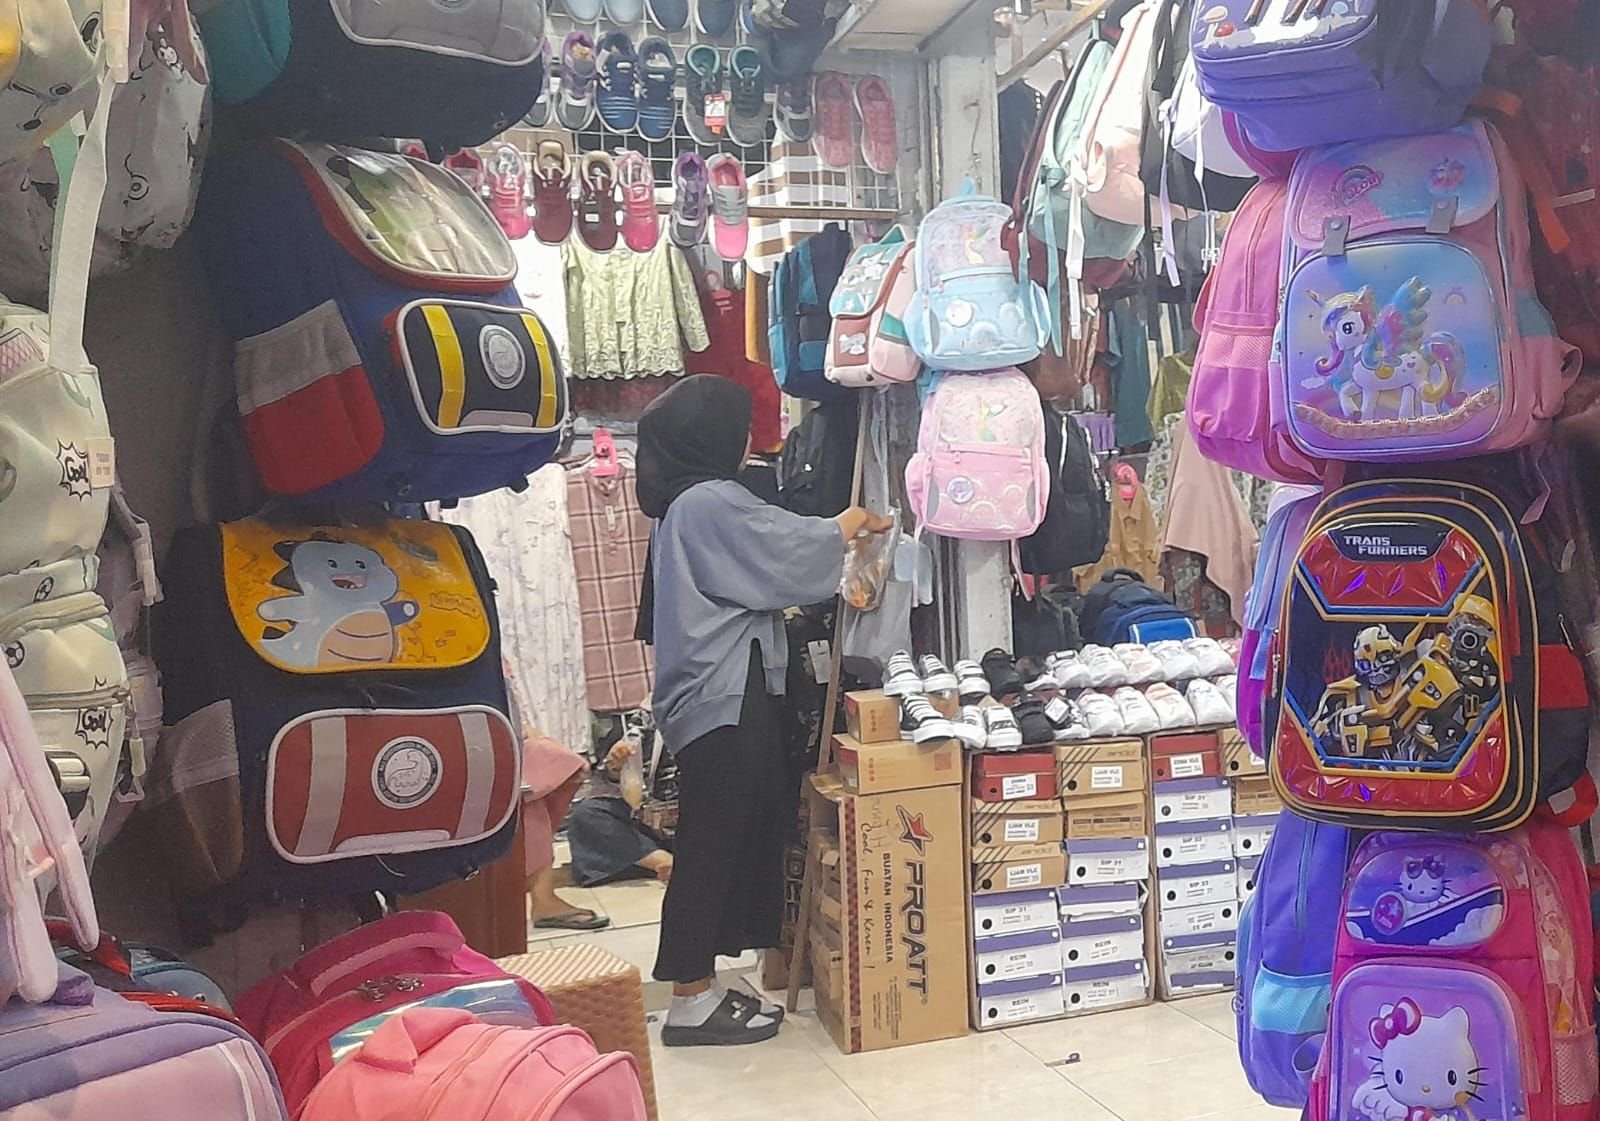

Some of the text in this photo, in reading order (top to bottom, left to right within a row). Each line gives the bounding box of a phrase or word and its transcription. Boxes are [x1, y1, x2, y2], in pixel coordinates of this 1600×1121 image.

[1343, 535, 1391, 546] TRANS
[1358, 545, 1428, 556] FORMERS
[882, 852, 892, 896] BUATAN
[883, 902, 894, 964] INDONESIA
[901, 859, 928, 996] PROATT
